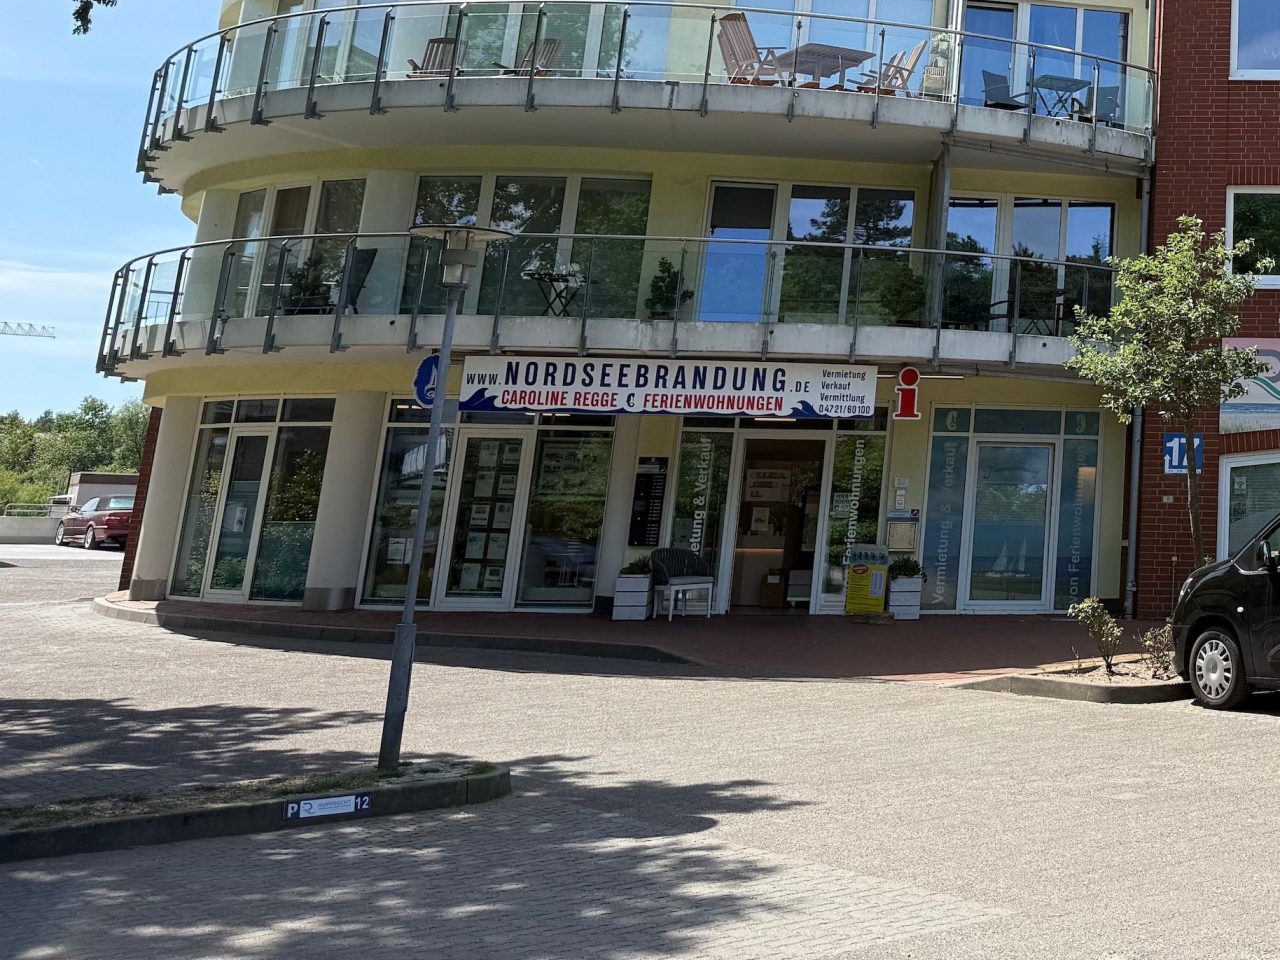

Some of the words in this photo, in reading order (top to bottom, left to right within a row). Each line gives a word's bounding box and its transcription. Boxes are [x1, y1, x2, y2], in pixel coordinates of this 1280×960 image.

[822, 369, 867, 381] Vermietung
[821, 381, 852, 391] Verkauf
[501, 389, 569, 406] CAROLINE
[573, 391, 618, 408] REGGE
[643, 393, 784, 412] FERIENWOHNUNGEN
[820, 393, 866, 404] Vermittlung
[818, 404, 871, 415] 04721/60100
[693, 436, 713, 493] Verkauf
[692, 496, 706, 507] &
[931, 521, 953, 604] Vermietung
[287, 803, 298, 818] P
[355, 796, 370, 809] 12
